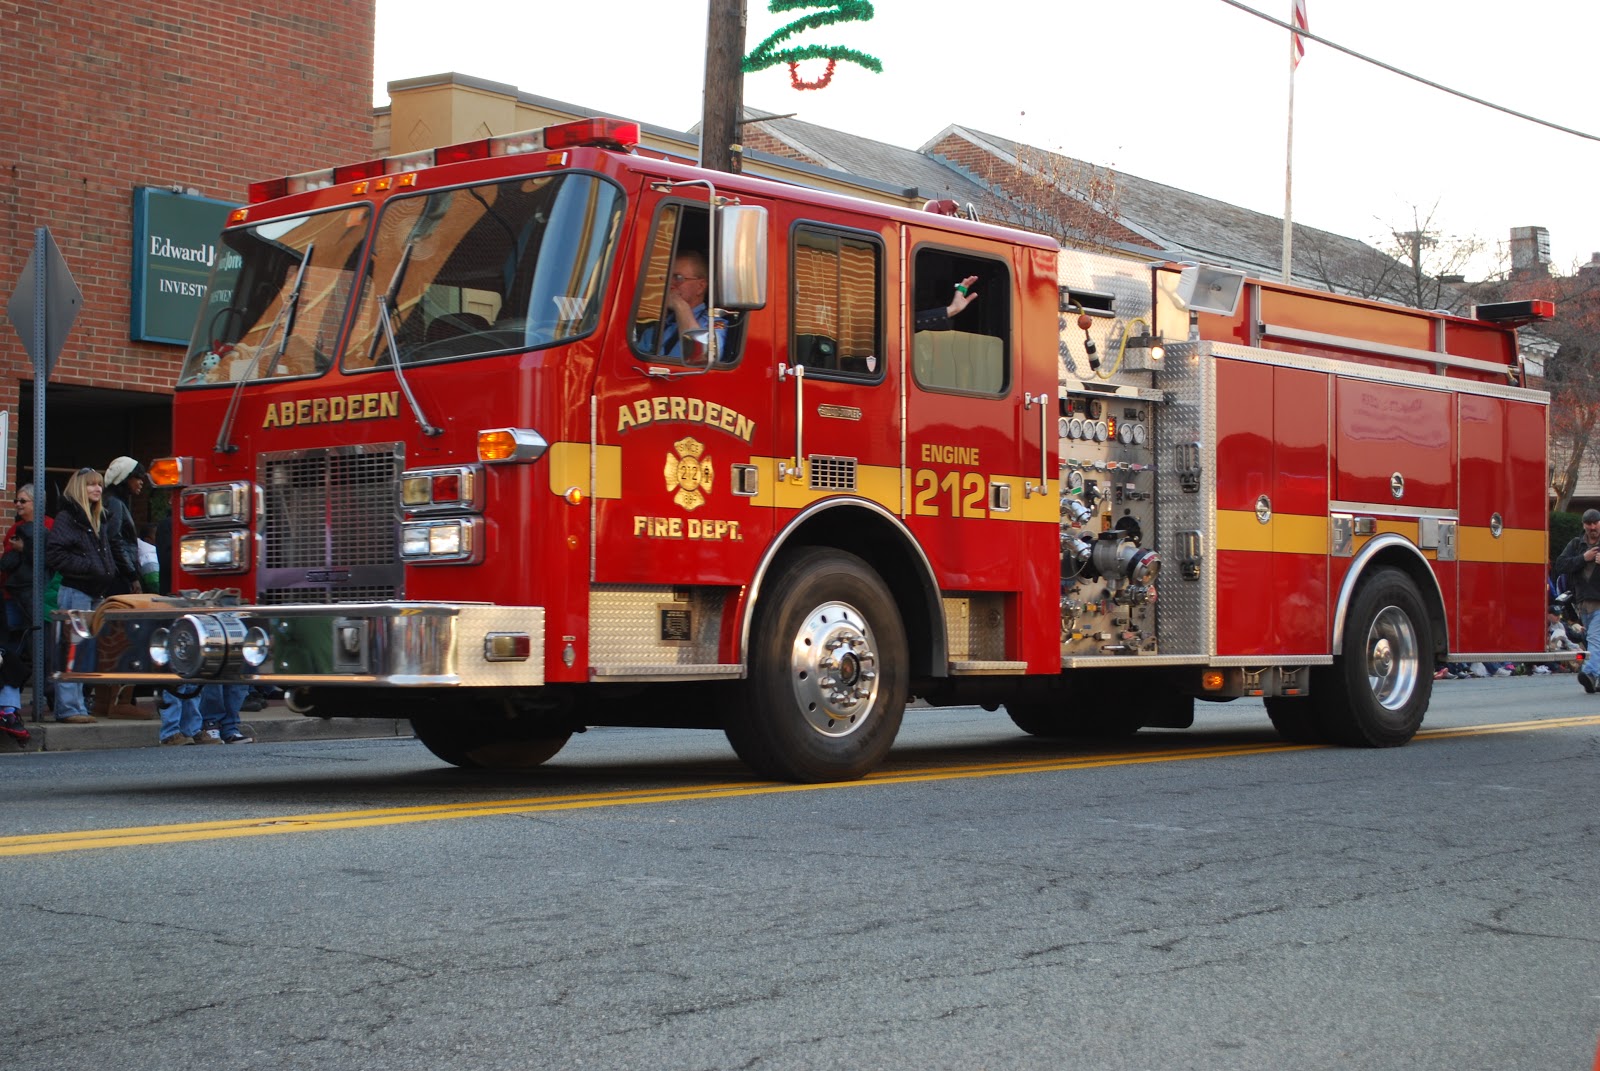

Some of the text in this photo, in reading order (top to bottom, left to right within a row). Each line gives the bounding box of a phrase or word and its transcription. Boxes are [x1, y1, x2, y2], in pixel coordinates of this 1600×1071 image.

[262, 391, 400, 428] ABERDEEN
[617, 396, 755, 443] ABERDEEN
[921, 443, 980, 466] ENGINE
[915, 468, 986, 519] 212
[633, 516, 743, 541] FIRE DEPT.
